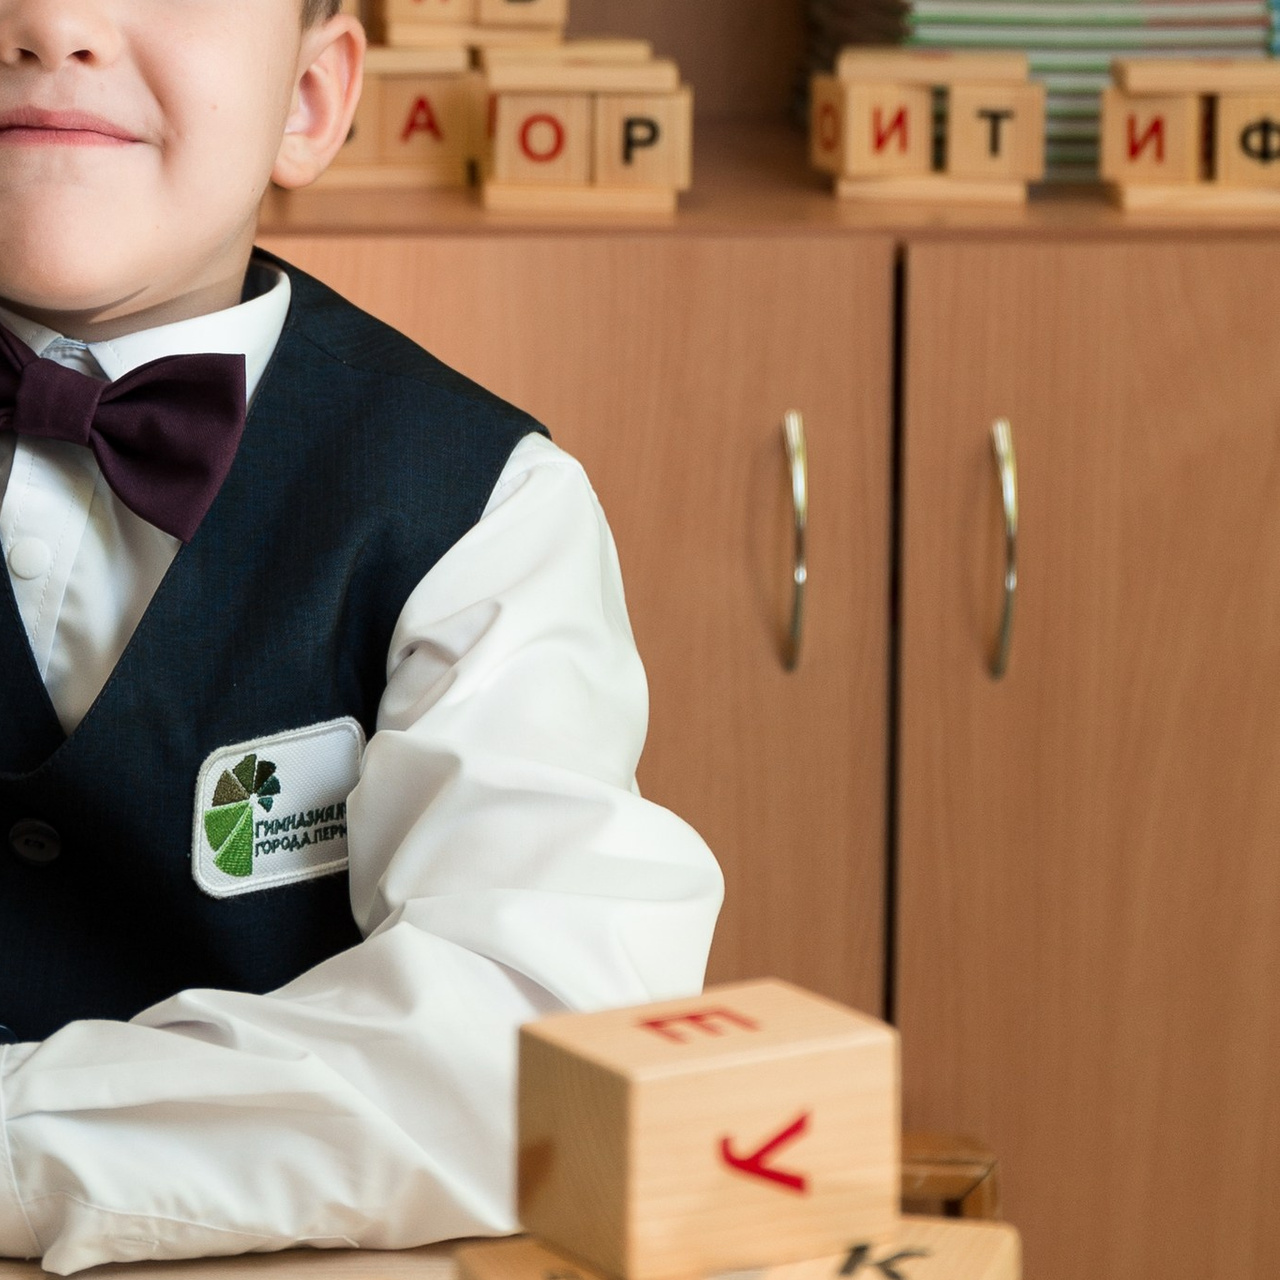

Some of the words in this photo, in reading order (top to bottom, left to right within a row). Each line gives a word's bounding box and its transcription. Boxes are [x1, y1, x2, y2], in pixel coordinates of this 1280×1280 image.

[399, 95, 444, 144] А
[518, 113, 566, 163] О
[621, 117, 661, 165] Р
[871, 104, 909, 156] И
[976, 106, 1015, 157] Т
[1126, 114, 1165, 164] И
[1238, 117, 1280, 164] Ф
[255, 803, 336, 839] ГИМНАЗИЯ
[255, 831, 311, 858] ГОРОДА
[634, 1004, 761, 1044] Е
[717, 1108, 811, 1195] У
